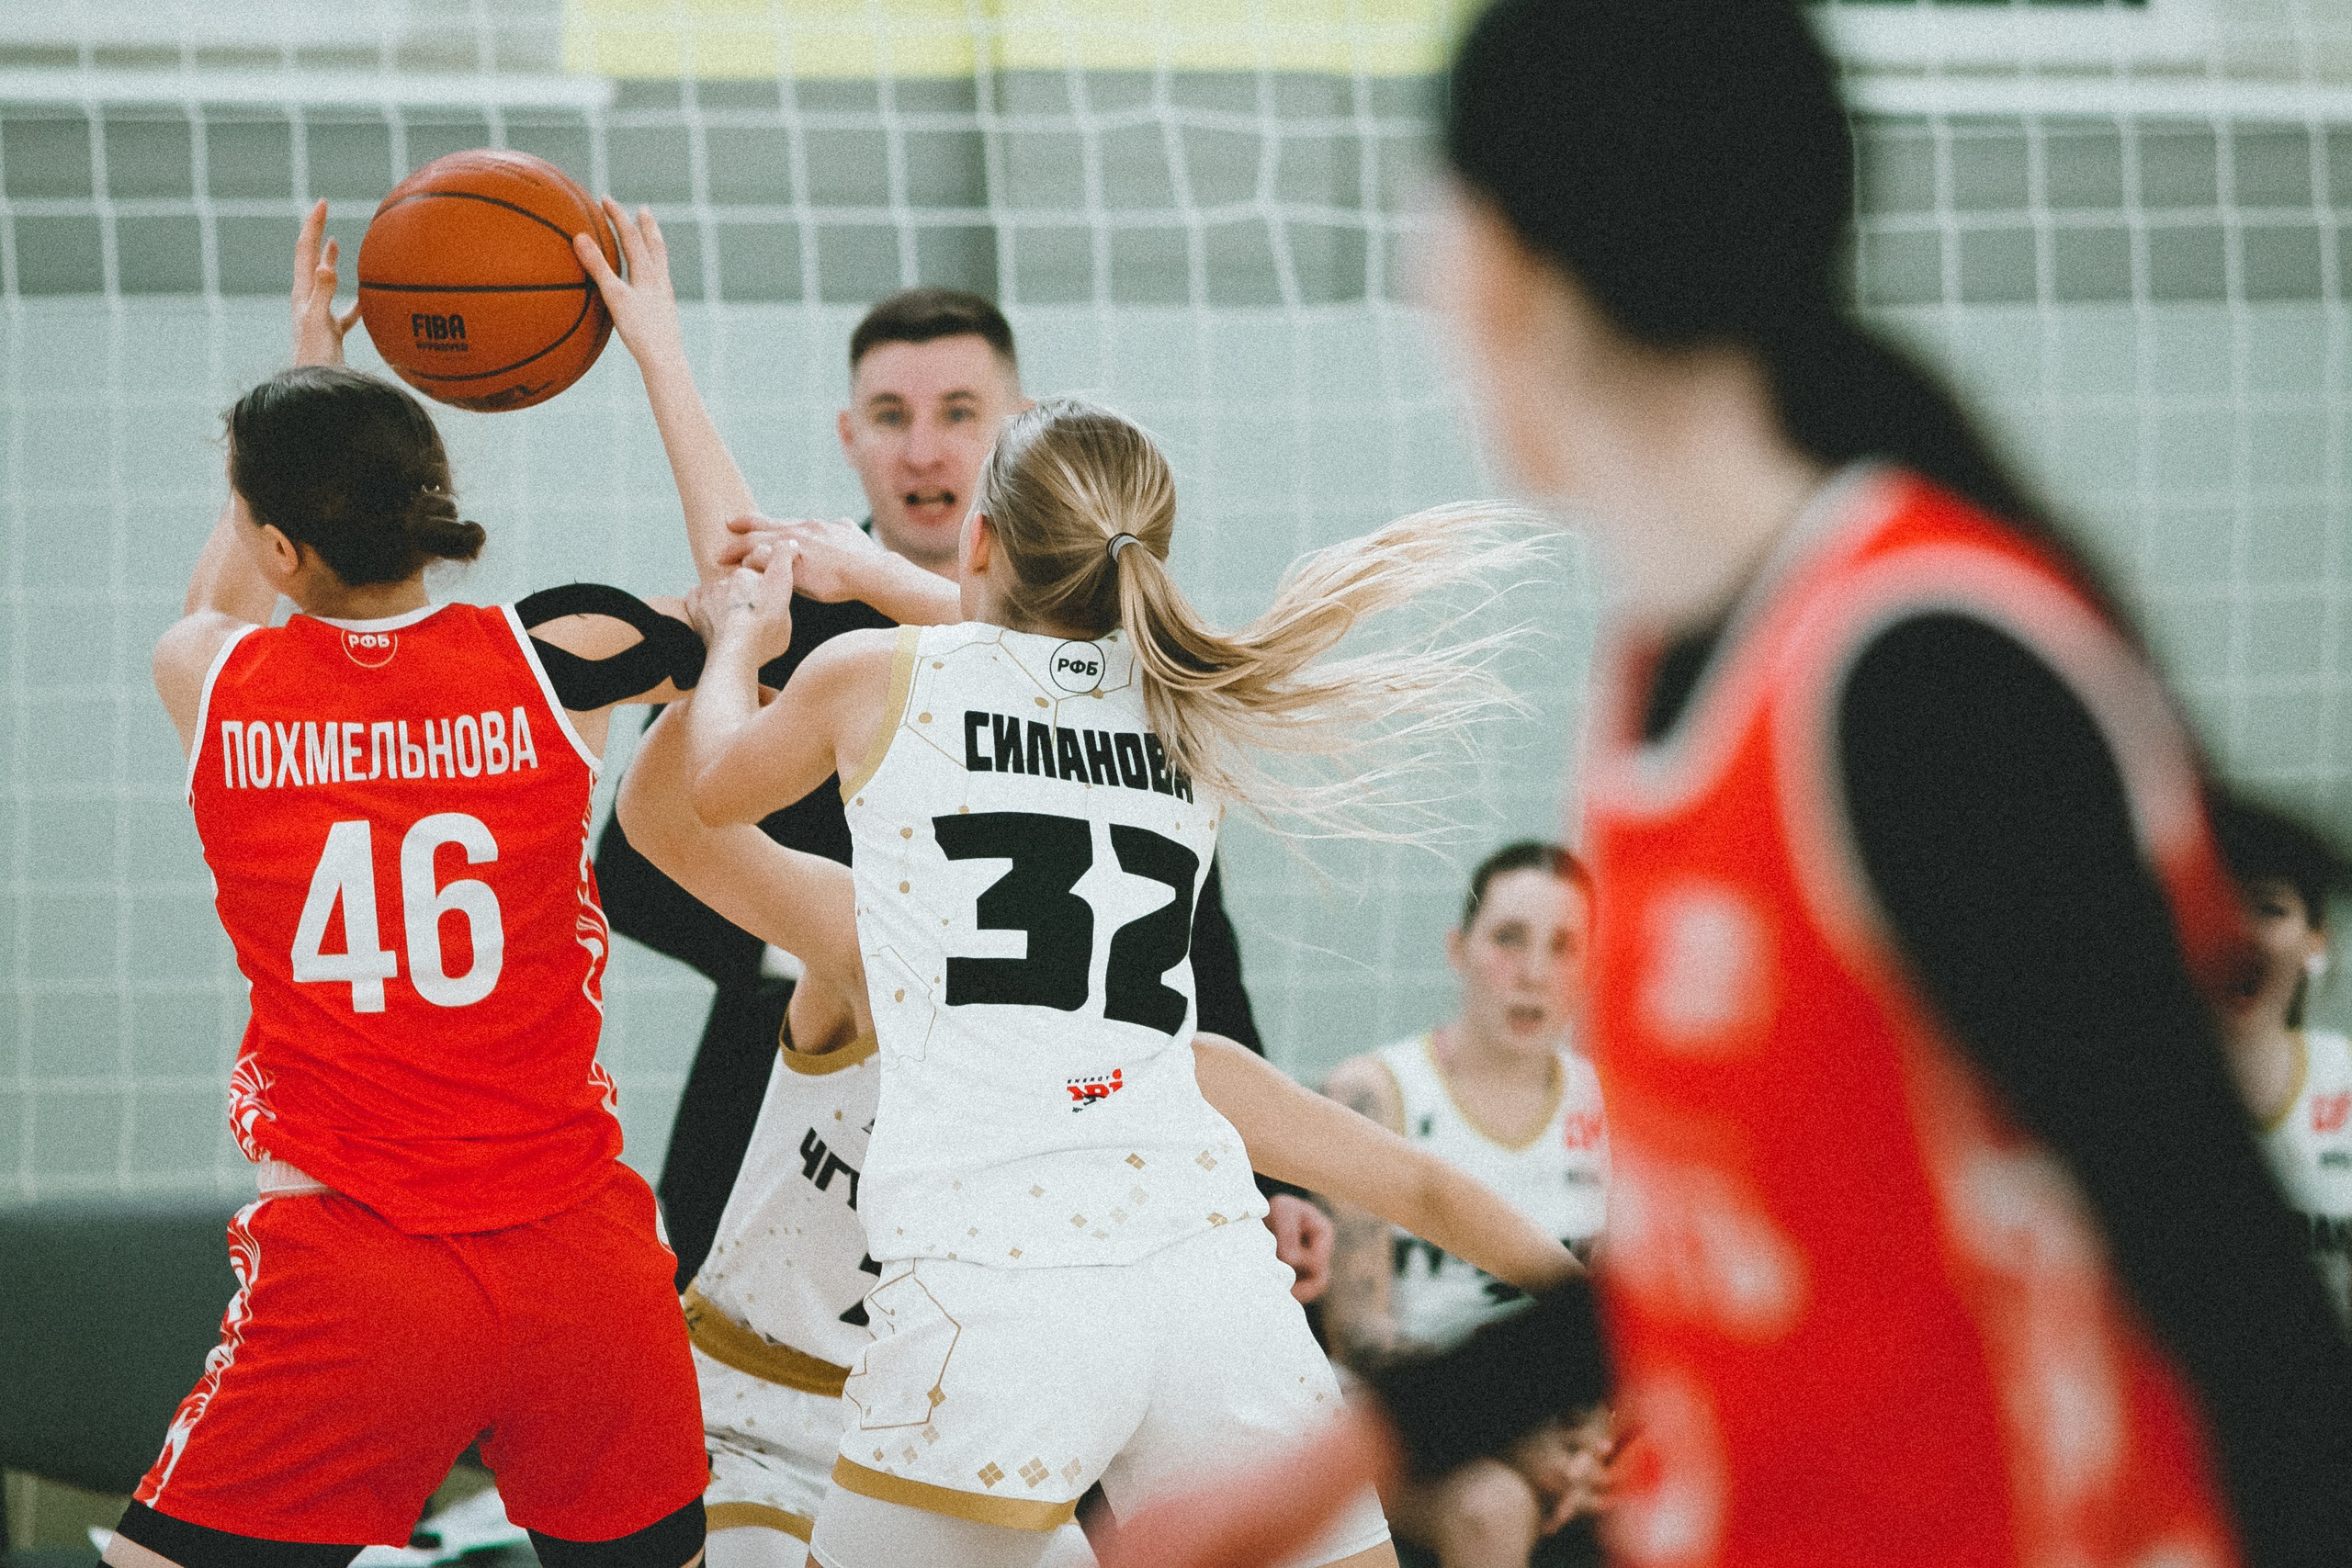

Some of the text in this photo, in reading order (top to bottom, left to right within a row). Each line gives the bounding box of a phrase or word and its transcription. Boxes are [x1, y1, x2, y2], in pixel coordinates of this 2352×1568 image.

[412, 313, 466, 339] FIBA
[348, 634, 390, 649] РФБ
[1057, 658, 1099, 676] РФБ
[221, 706, 538, 789] ПОХМЕЛЬНОВА
[290, 812, 504, 1013] 46
[932, 812, 1200, 1037] 32
